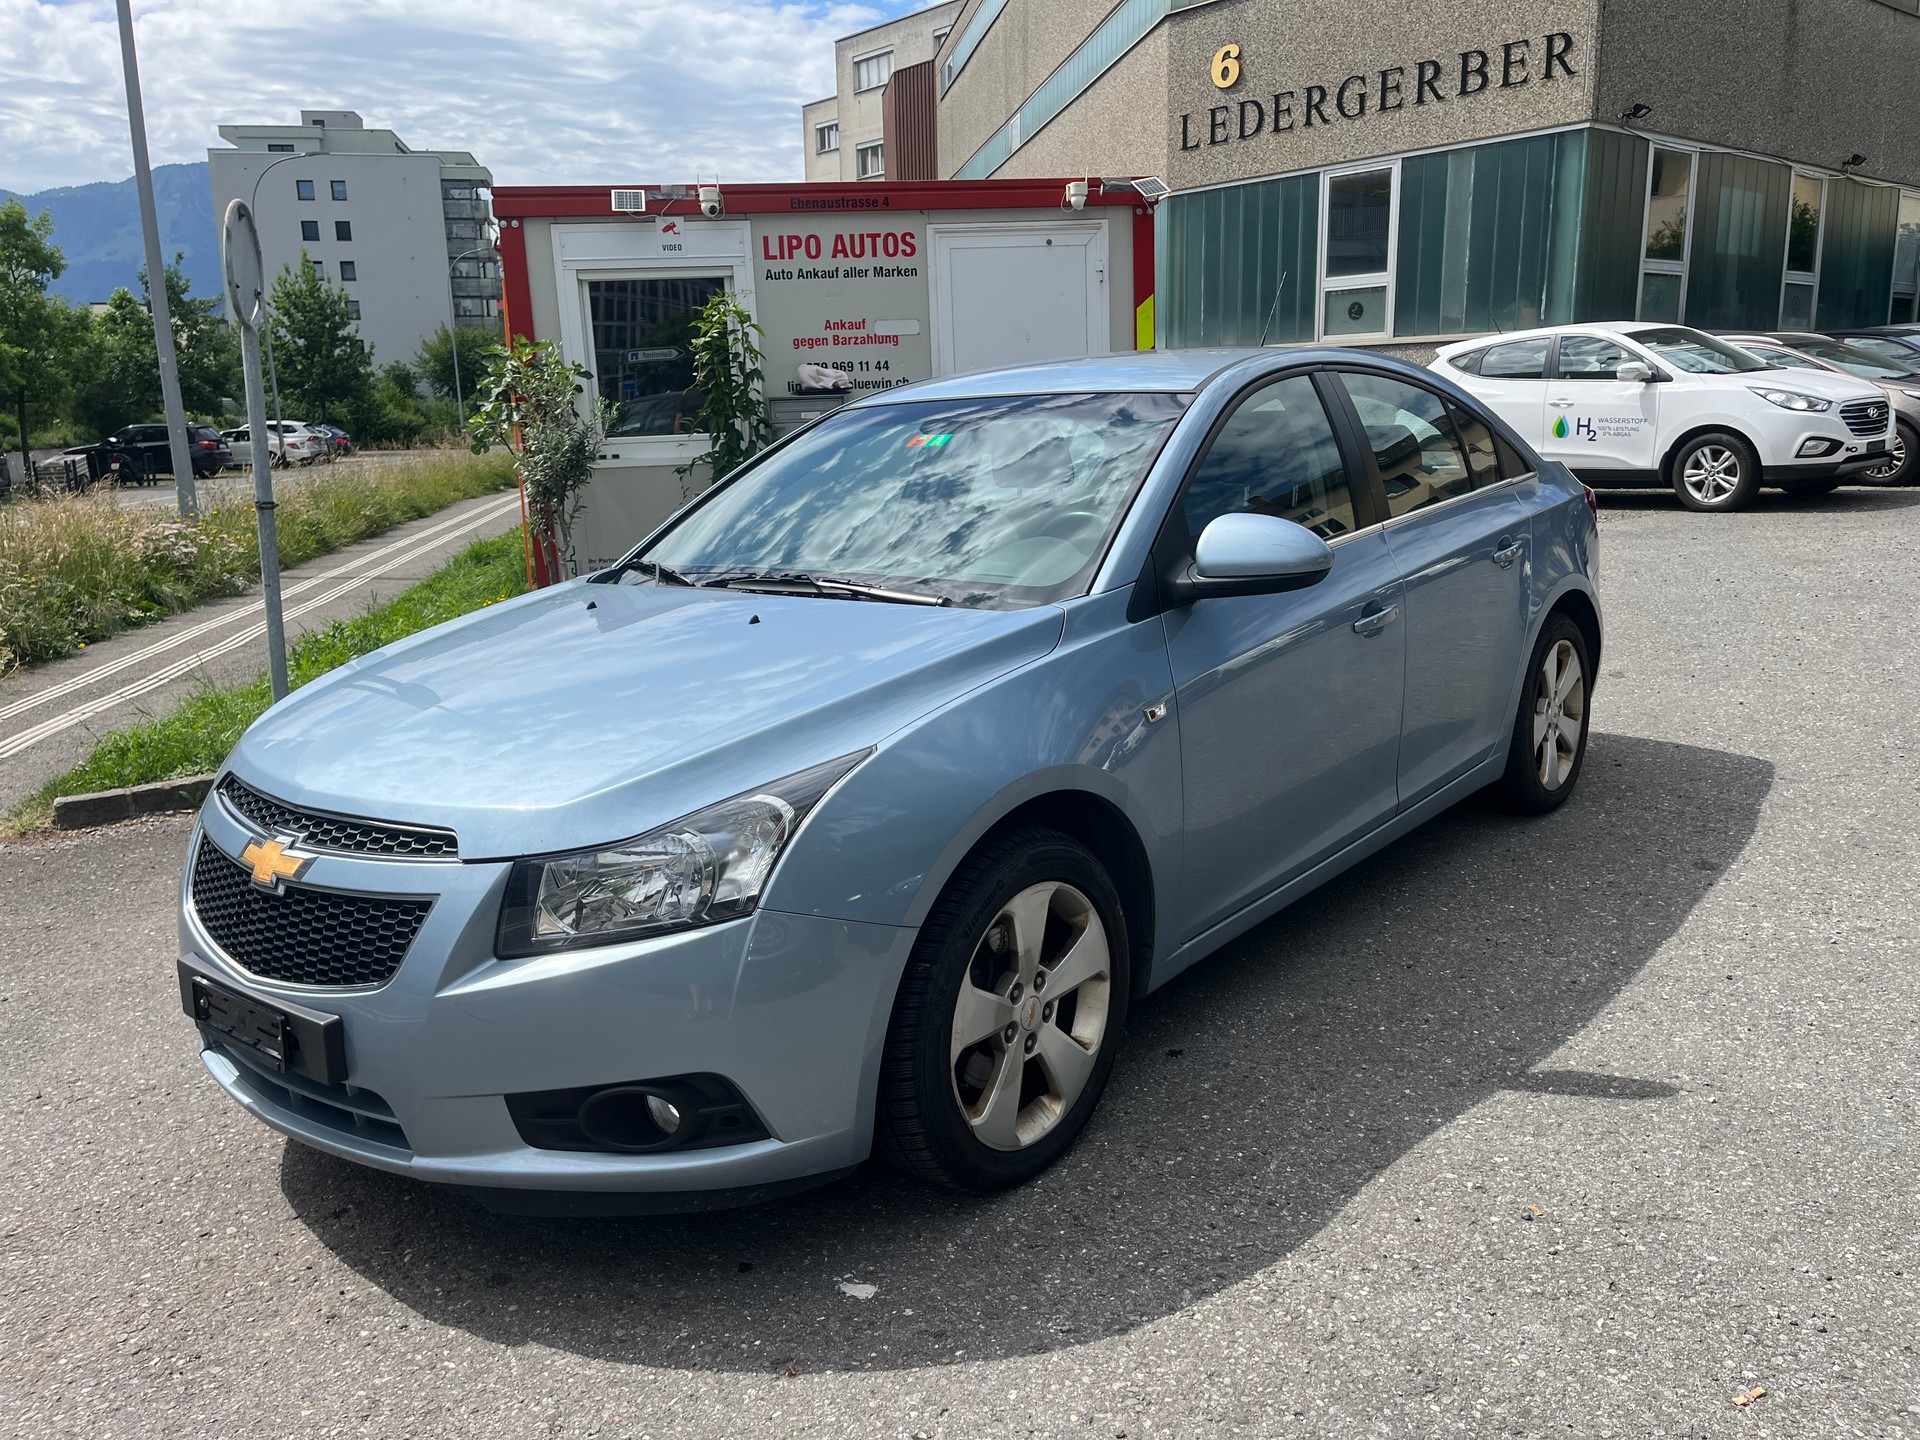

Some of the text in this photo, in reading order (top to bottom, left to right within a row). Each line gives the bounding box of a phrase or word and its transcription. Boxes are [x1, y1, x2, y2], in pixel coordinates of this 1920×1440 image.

[1210, 43, 1241, 89] 6
[1178, 31, 1578, 151] LEDERGERBER
[790, 196, 890, 209] Ebenaustrasse 4
[661, 243, 683, 252] VIDEO
[762, 231, 917, 261] LIPO AUTOS
[765, 266, 918, 281] Auto Ankauf aller Marken
[824, 318, 867, 331] Ankauf
[793, 333, 899, 350] gegen Barzahlung
[832, 361, 854, 372] 969
[858, 360, 870, 372] 11
[874, 360, 890, 371] 44
